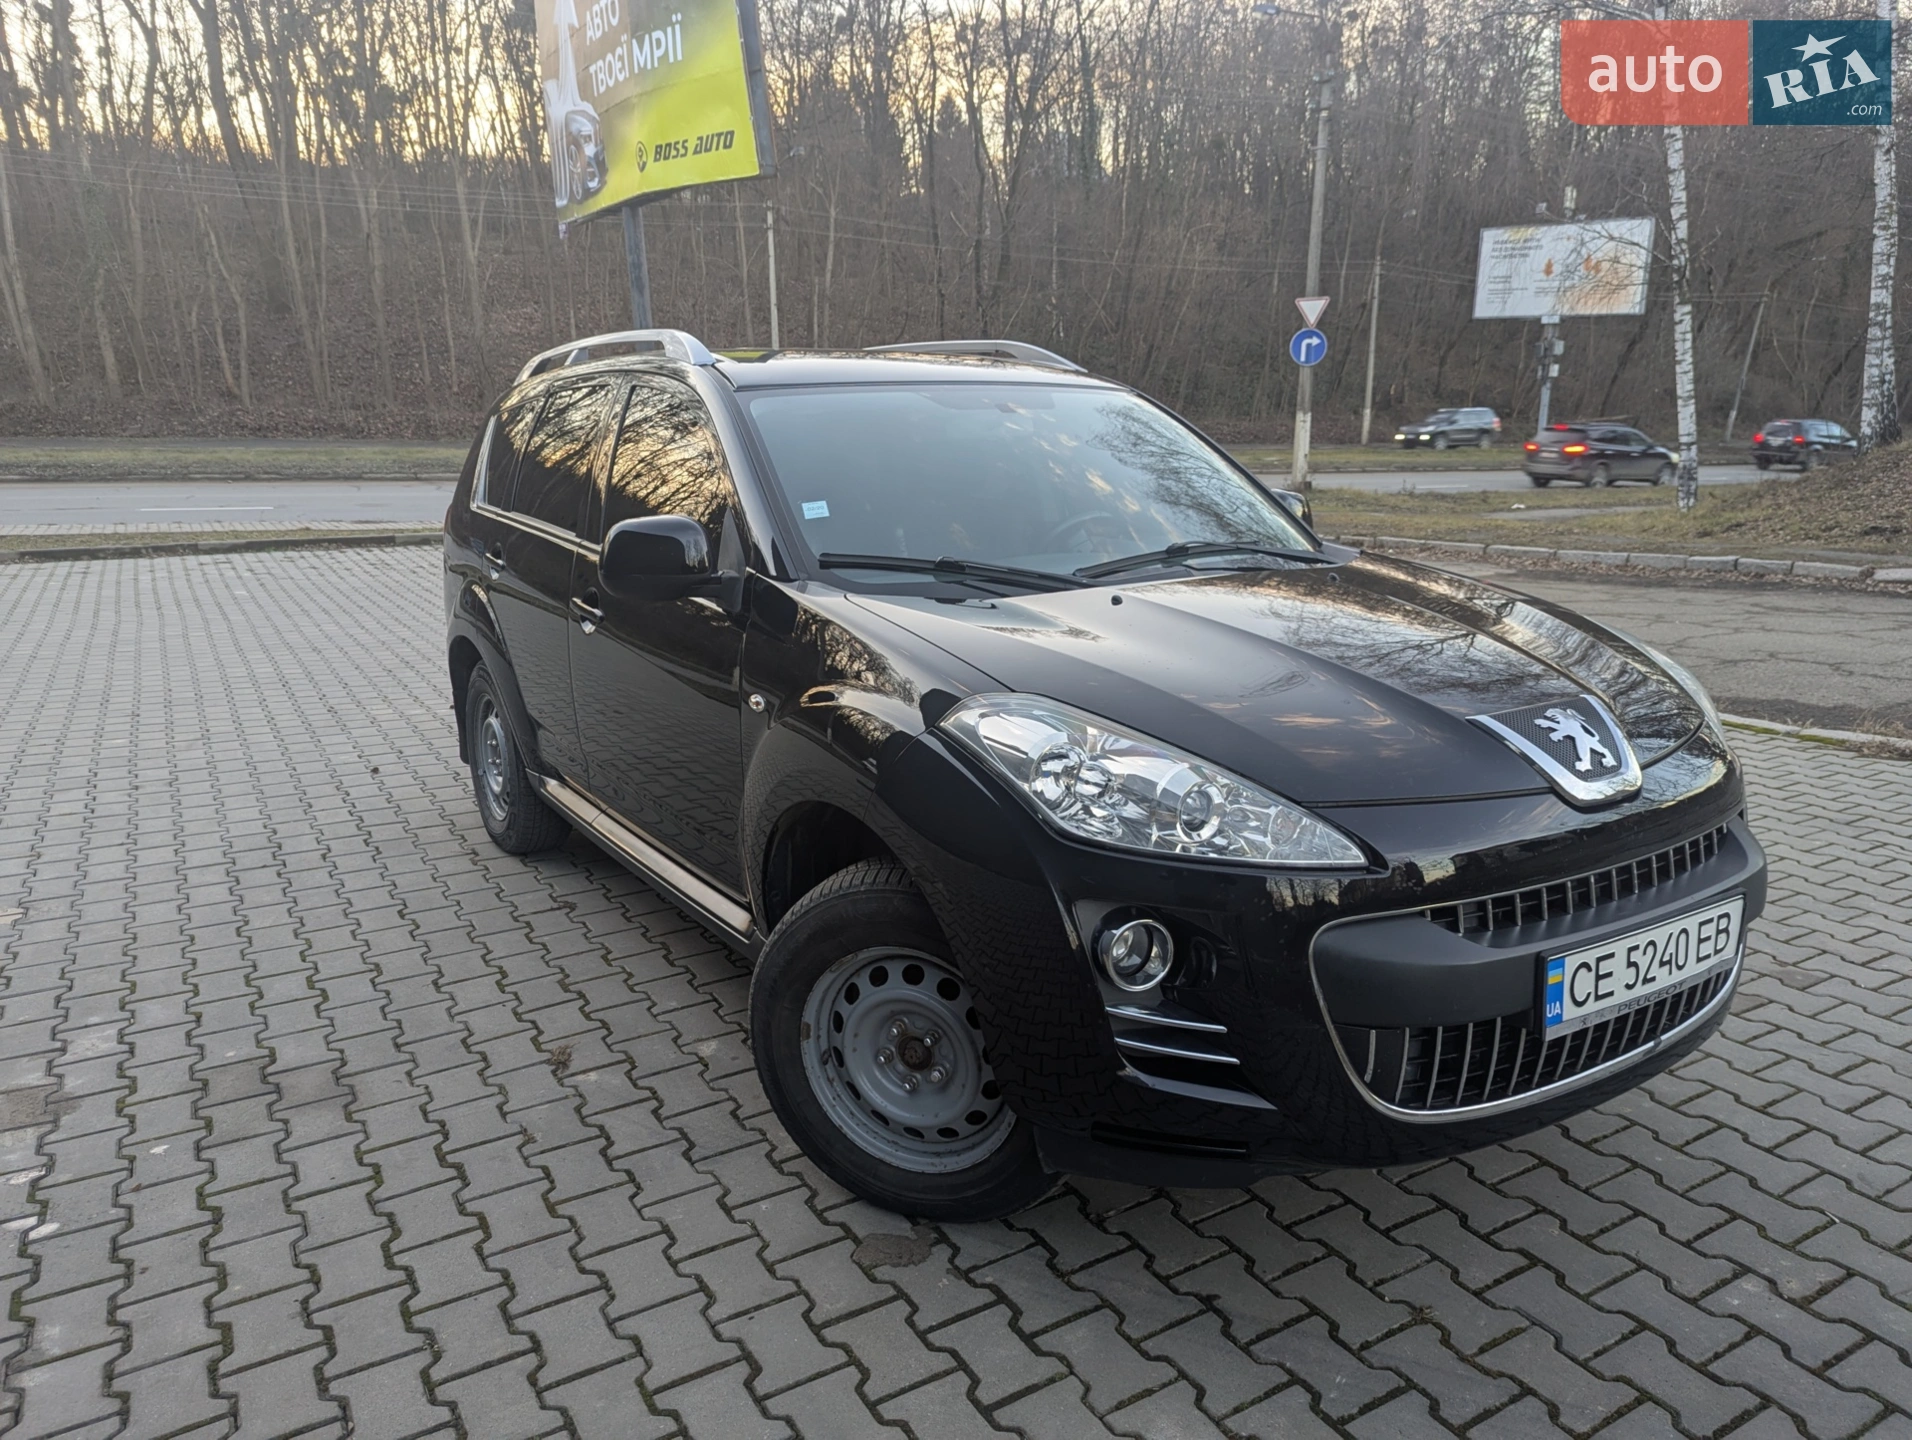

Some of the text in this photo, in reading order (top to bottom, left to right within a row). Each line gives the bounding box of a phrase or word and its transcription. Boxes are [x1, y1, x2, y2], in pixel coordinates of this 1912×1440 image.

[586, 0, 620, 46] АВТО
[588, 12, 683, 97] ТВОЄЇ МРІЇ
[653, 129, 735, 163] BOSS AUTO
[1569, 911, 1732, 1008] CE 5240 EB
[1546, 1001, 1562, 1018] UA
[1616, 980, 1688, 1015] PEUGEOT
